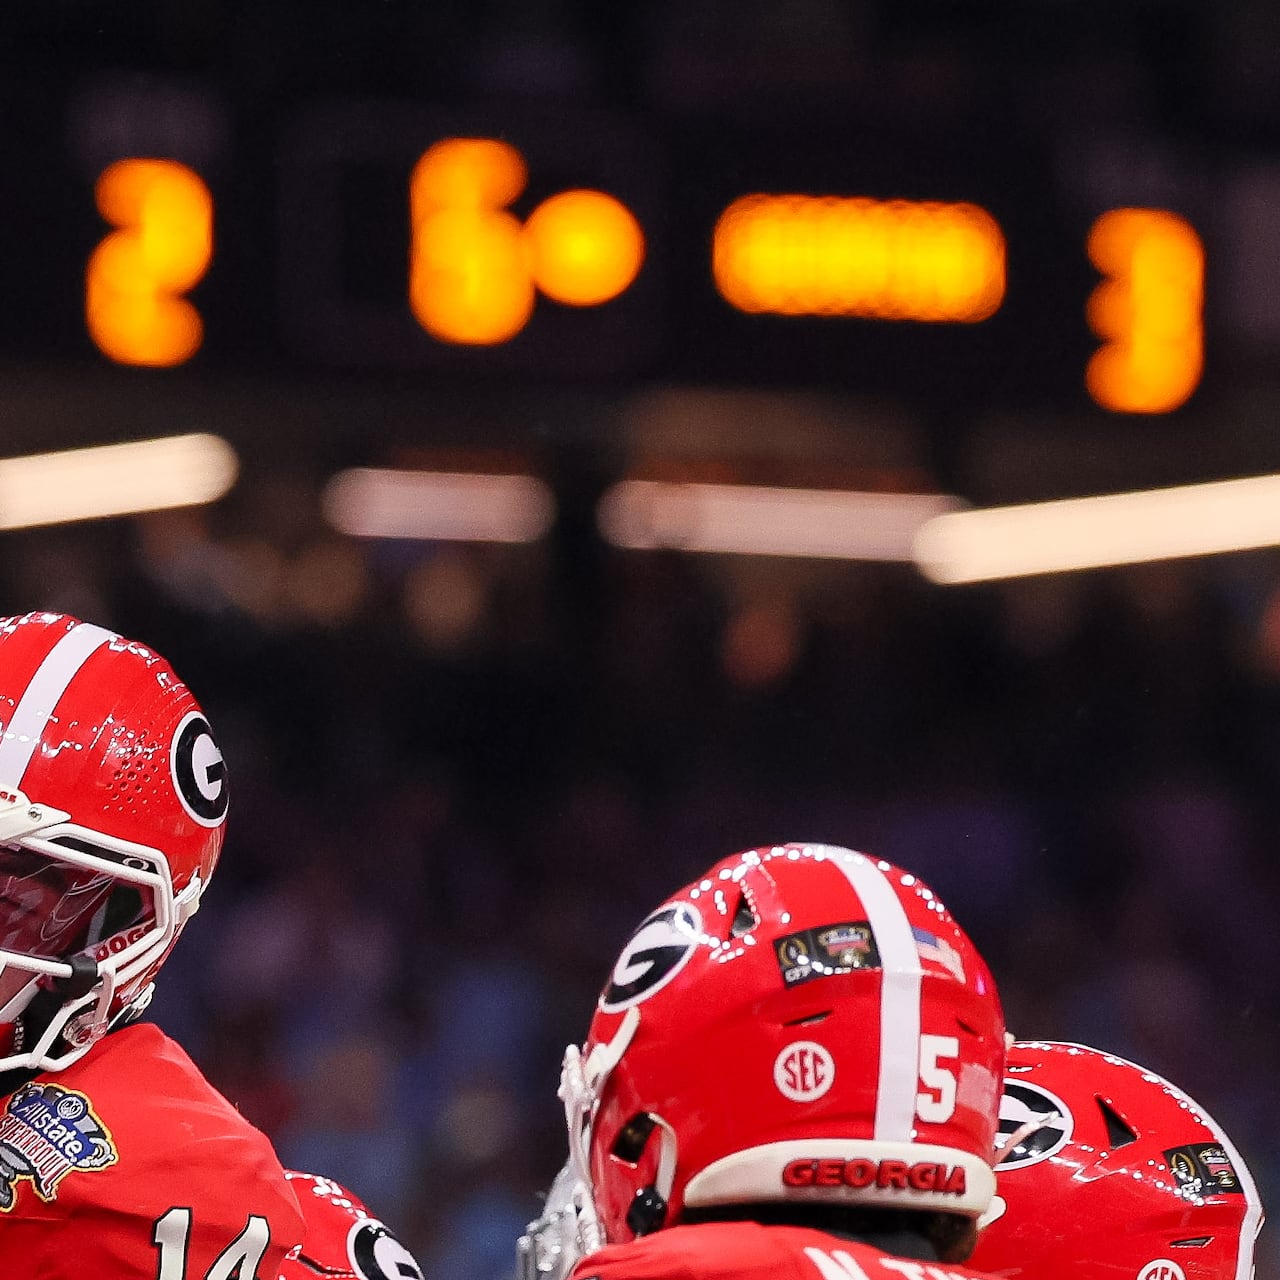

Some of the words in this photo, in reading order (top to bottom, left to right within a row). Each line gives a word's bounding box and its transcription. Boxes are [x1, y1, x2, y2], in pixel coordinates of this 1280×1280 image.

[781, 1047, 827, 1094] SEC
[915, 1033, 960, 1124] 5
[782, 1158, 967, 1195] GEORGIA
